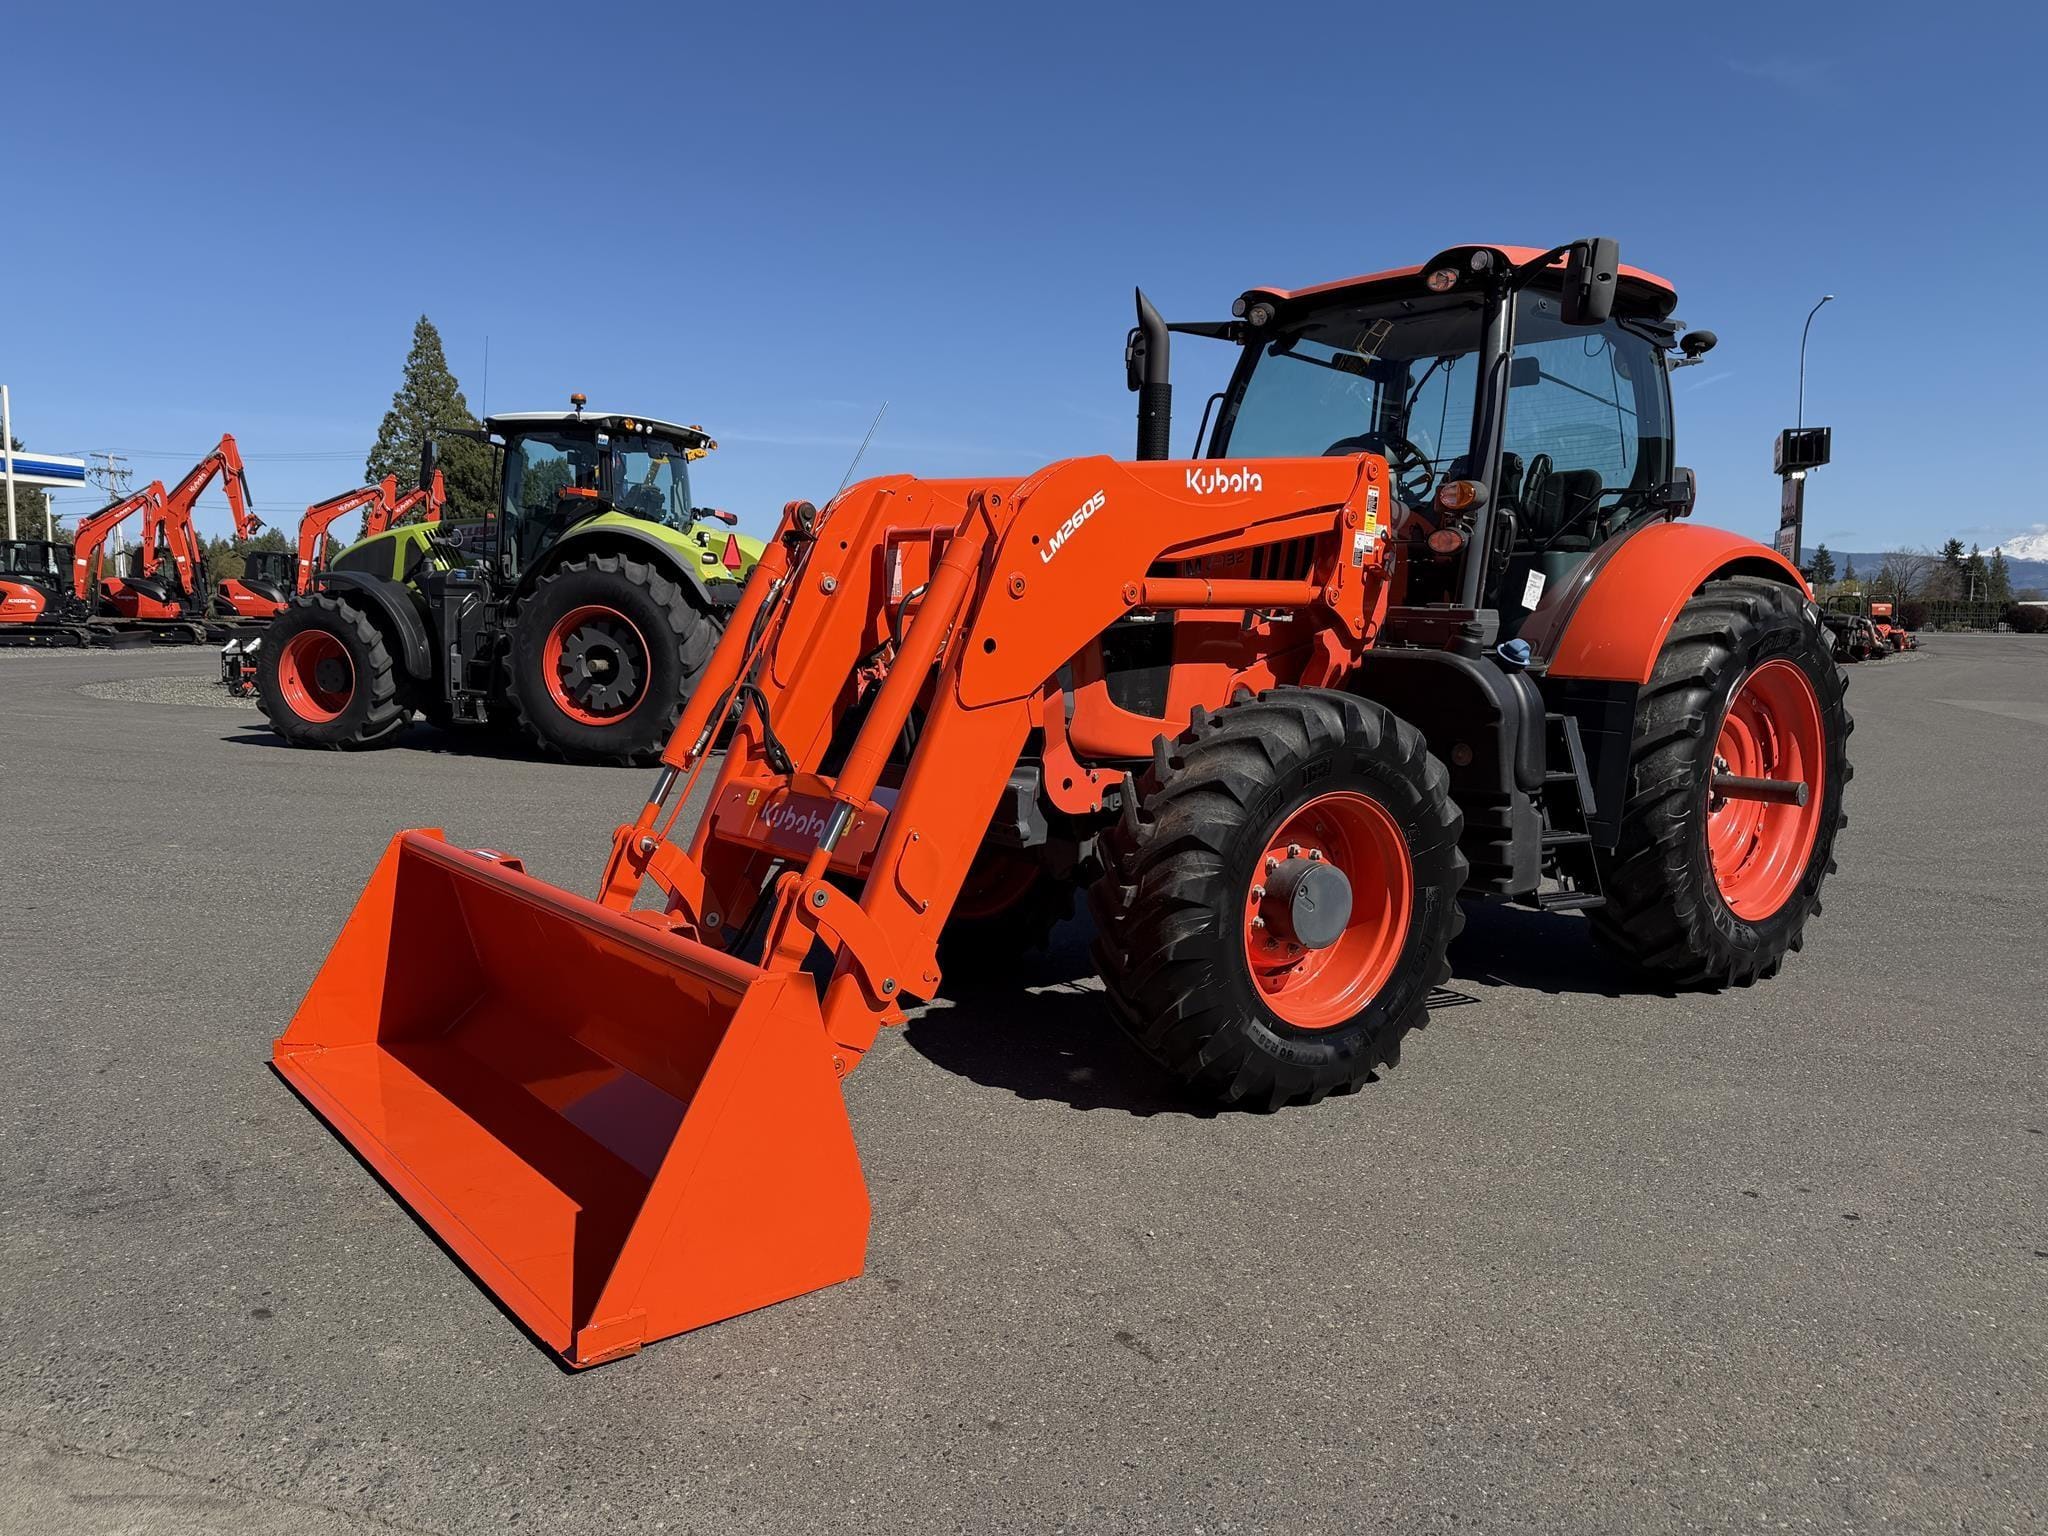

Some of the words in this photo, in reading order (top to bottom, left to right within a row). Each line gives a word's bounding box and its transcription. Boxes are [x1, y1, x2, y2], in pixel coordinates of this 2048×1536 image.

[1186, 466, 1262, 495] Kubota
[1040, 489, 1106, 564] LM2605
[760, 800, 826, 838] Kubota
